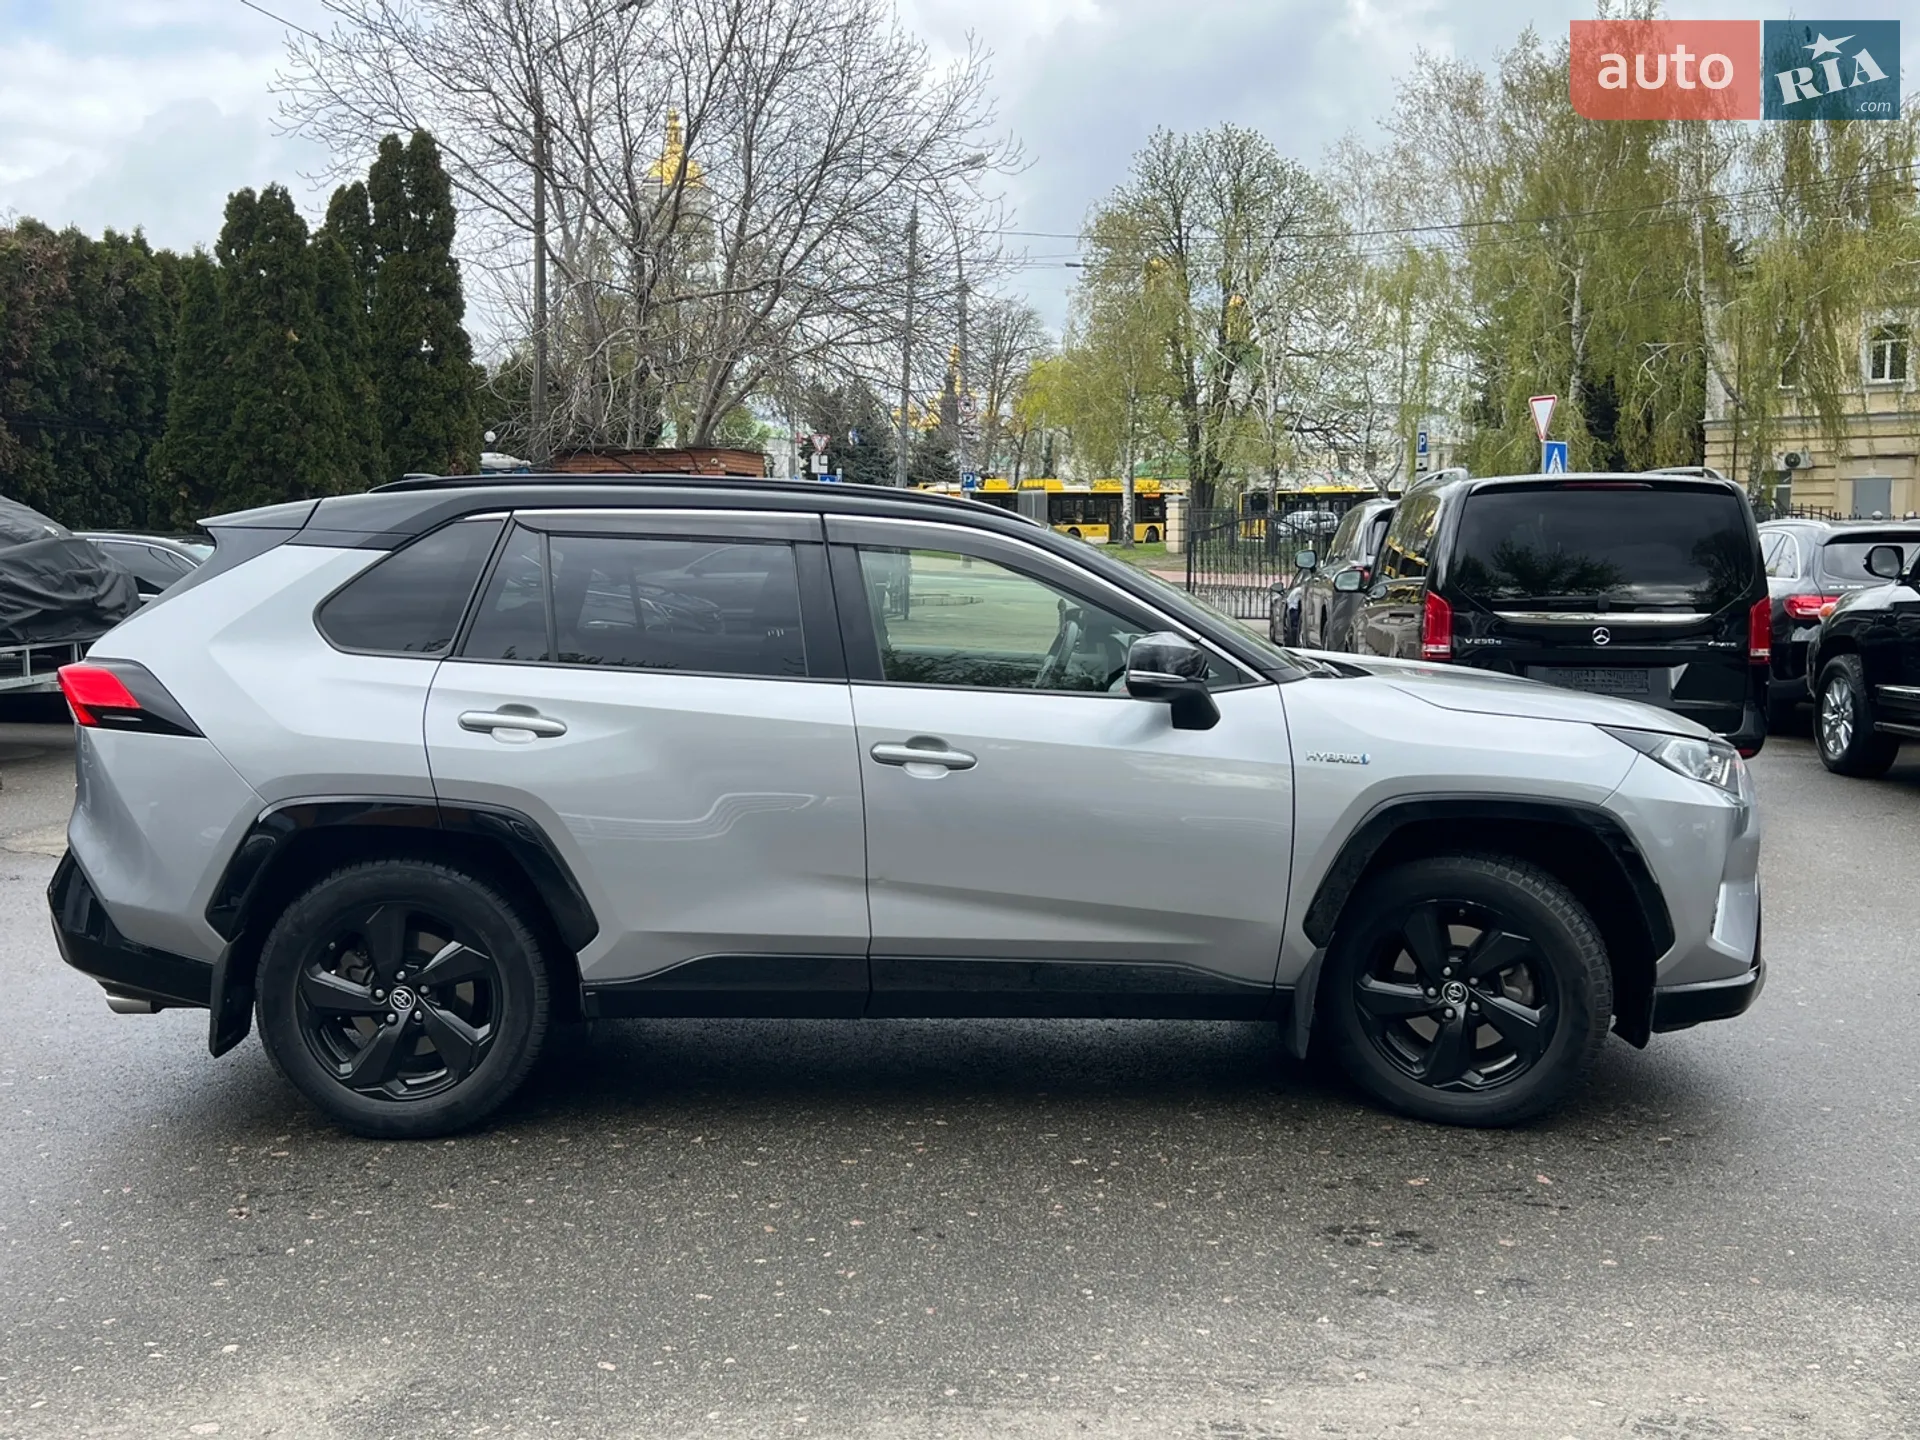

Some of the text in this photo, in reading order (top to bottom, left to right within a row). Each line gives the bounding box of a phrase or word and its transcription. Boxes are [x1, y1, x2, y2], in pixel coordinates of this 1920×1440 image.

[1418, 434, 1427, 451] P
[962, 473, 974, 486] P
[1305, 750, 1361, 765] HYBRID
